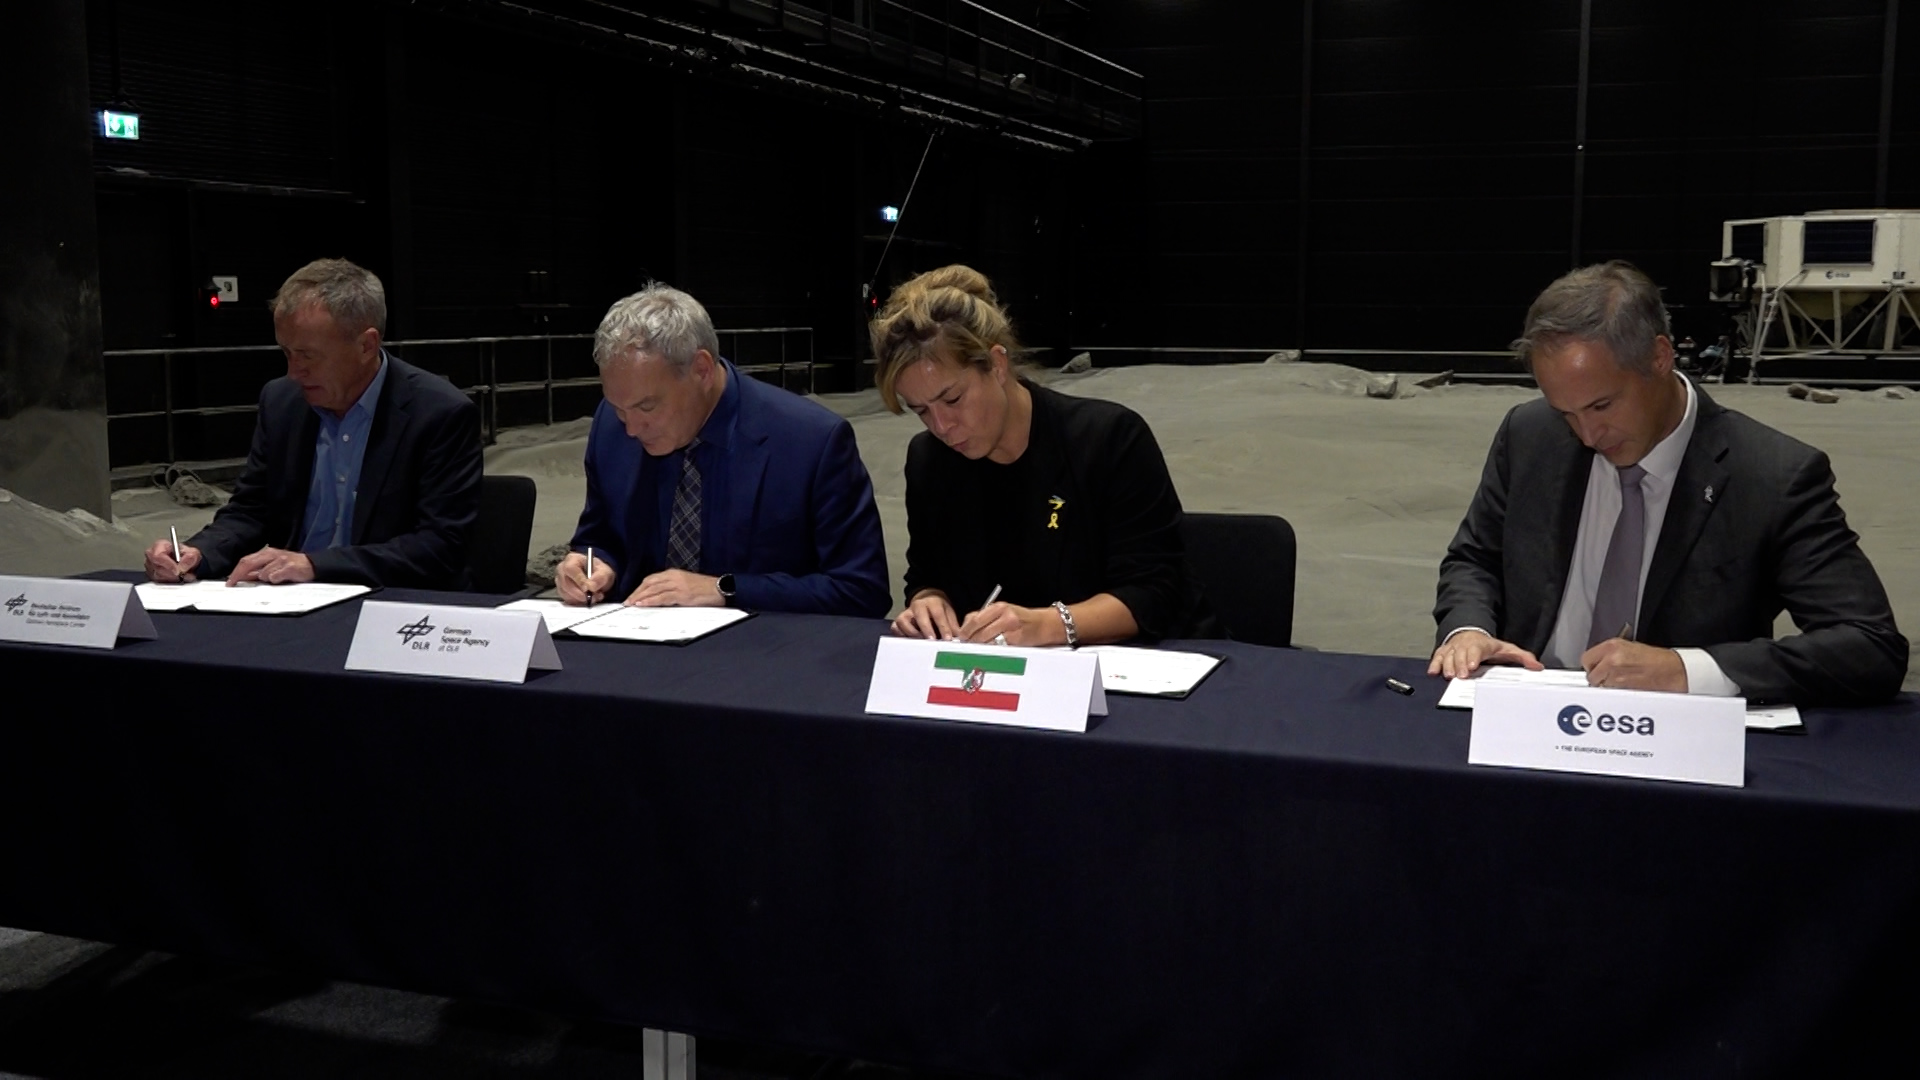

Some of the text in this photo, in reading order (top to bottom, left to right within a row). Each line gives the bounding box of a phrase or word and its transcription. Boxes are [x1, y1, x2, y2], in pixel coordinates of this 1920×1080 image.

[443, 626, 472, 635] German
[412, 641, 430, 650] DLR
[441, 635, 490, 647] Space Agency
[1597, 713, 1655, 736] esa
[1574, 746, 1608, 754] EUROPEAN
